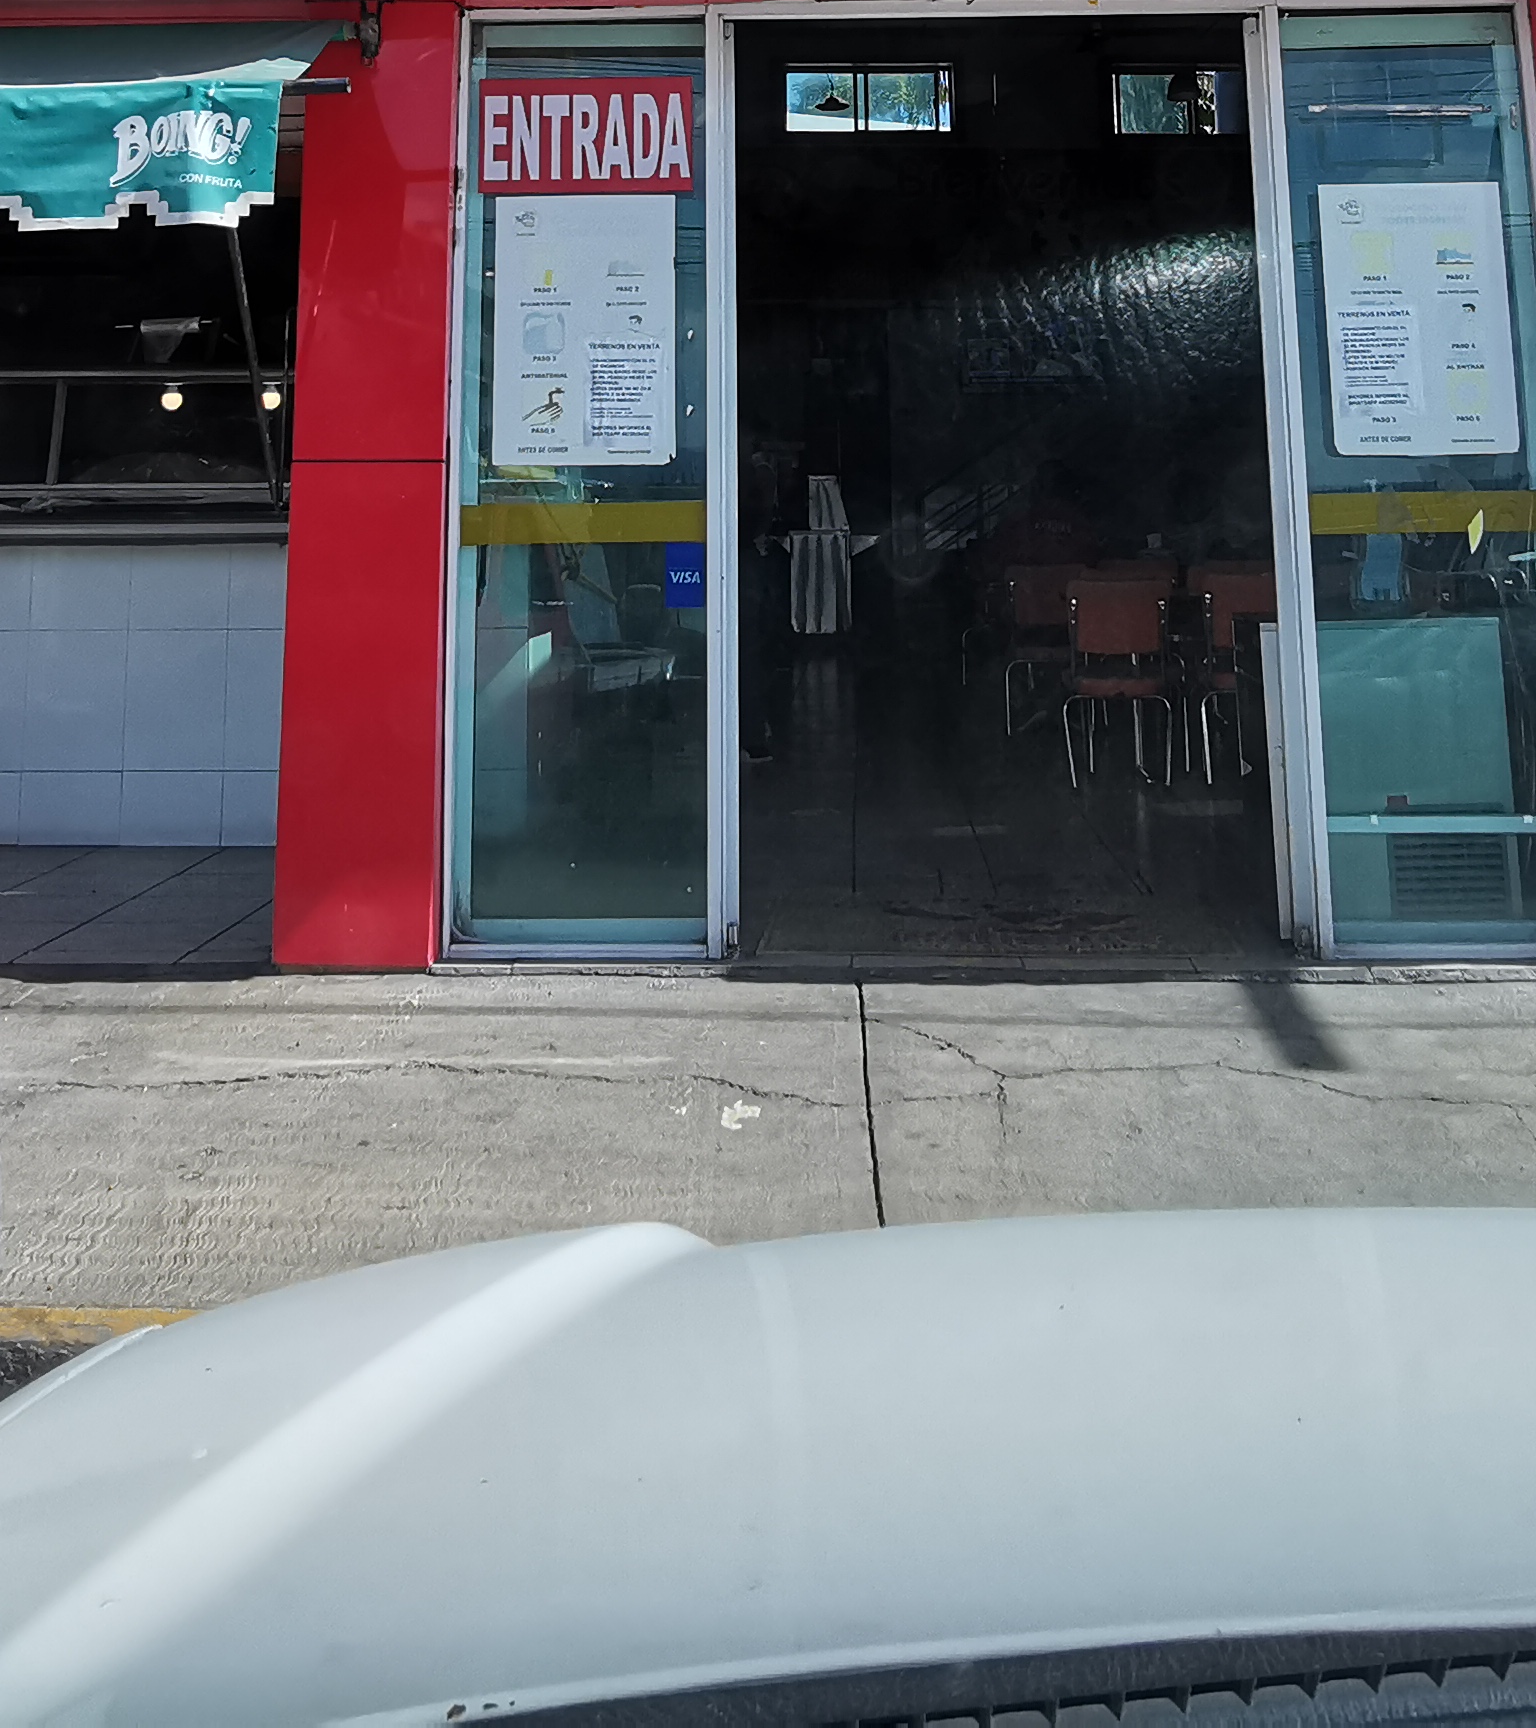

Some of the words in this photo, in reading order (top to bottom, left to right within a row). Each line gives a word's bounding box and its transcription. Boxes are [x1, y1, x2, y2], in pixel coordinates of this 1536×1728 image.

[109, 110, 253, 188] BOING!
[483, 92, 691, 182] ENTRADA
[179, 173, 204, 184] CON
[205, 176, 243, 189] FRUTA
[669, 571, 701, 584] VISA
